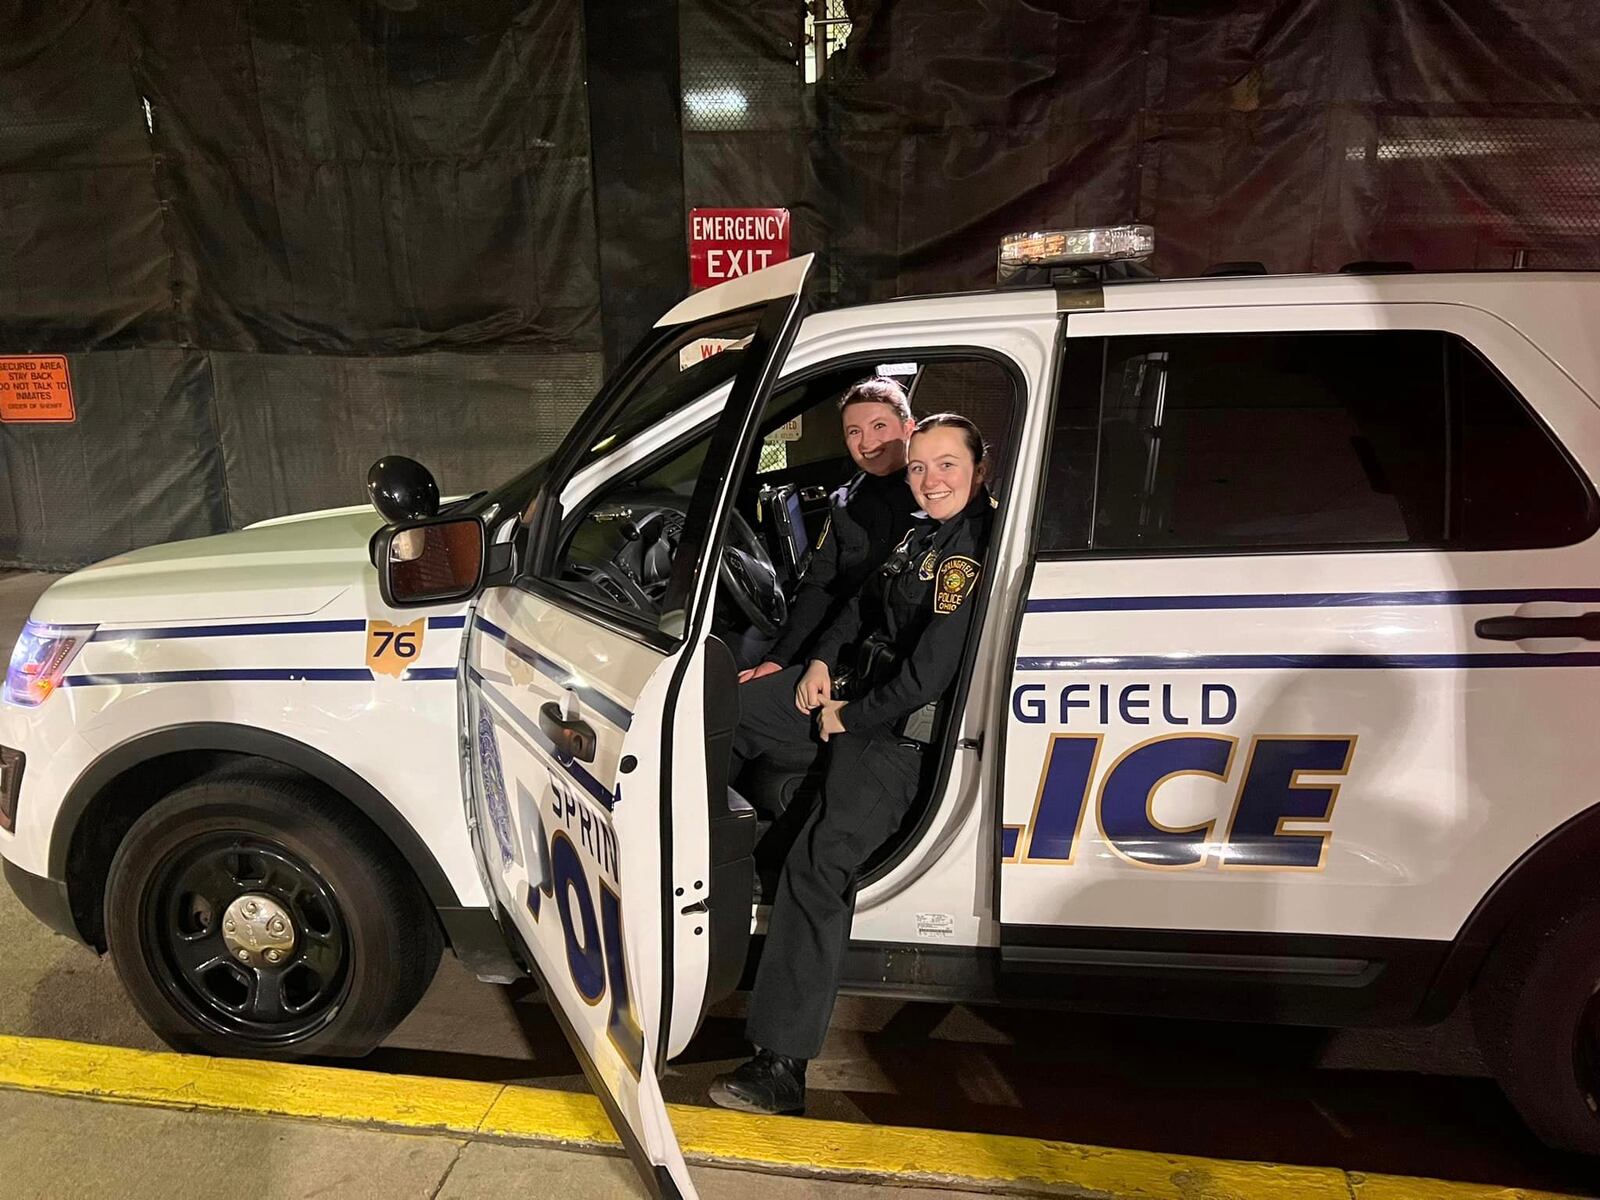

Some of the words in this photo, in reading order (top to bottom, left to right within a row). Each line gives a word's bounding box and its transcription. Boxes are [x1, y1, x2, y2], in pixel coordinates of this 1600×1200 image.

[693, 217, 785, 241] EMERGENCY
[707, 250, 772, 278] EXIT
[40, 362, 62, 370] AREA
[8, 372, 27, 380] STAY
[31, 372, 53, 380] BACK
[13, 382, 29, 390] NOT
[33, 382, 53, 390] TALK
[56, 382, 67, 390] TO
[16, 392, 52, 400] INMATES
[941, 560, 975, 578] SPRINGFIELD
[937, 592, 963, 605] POLICE
[938, 602, 957, 611] OHIO
[373, 632, 416, 658] 76
[1012, 683, 1237, 725] GFIELD
[548, 776, 620, 885] SPRIN
